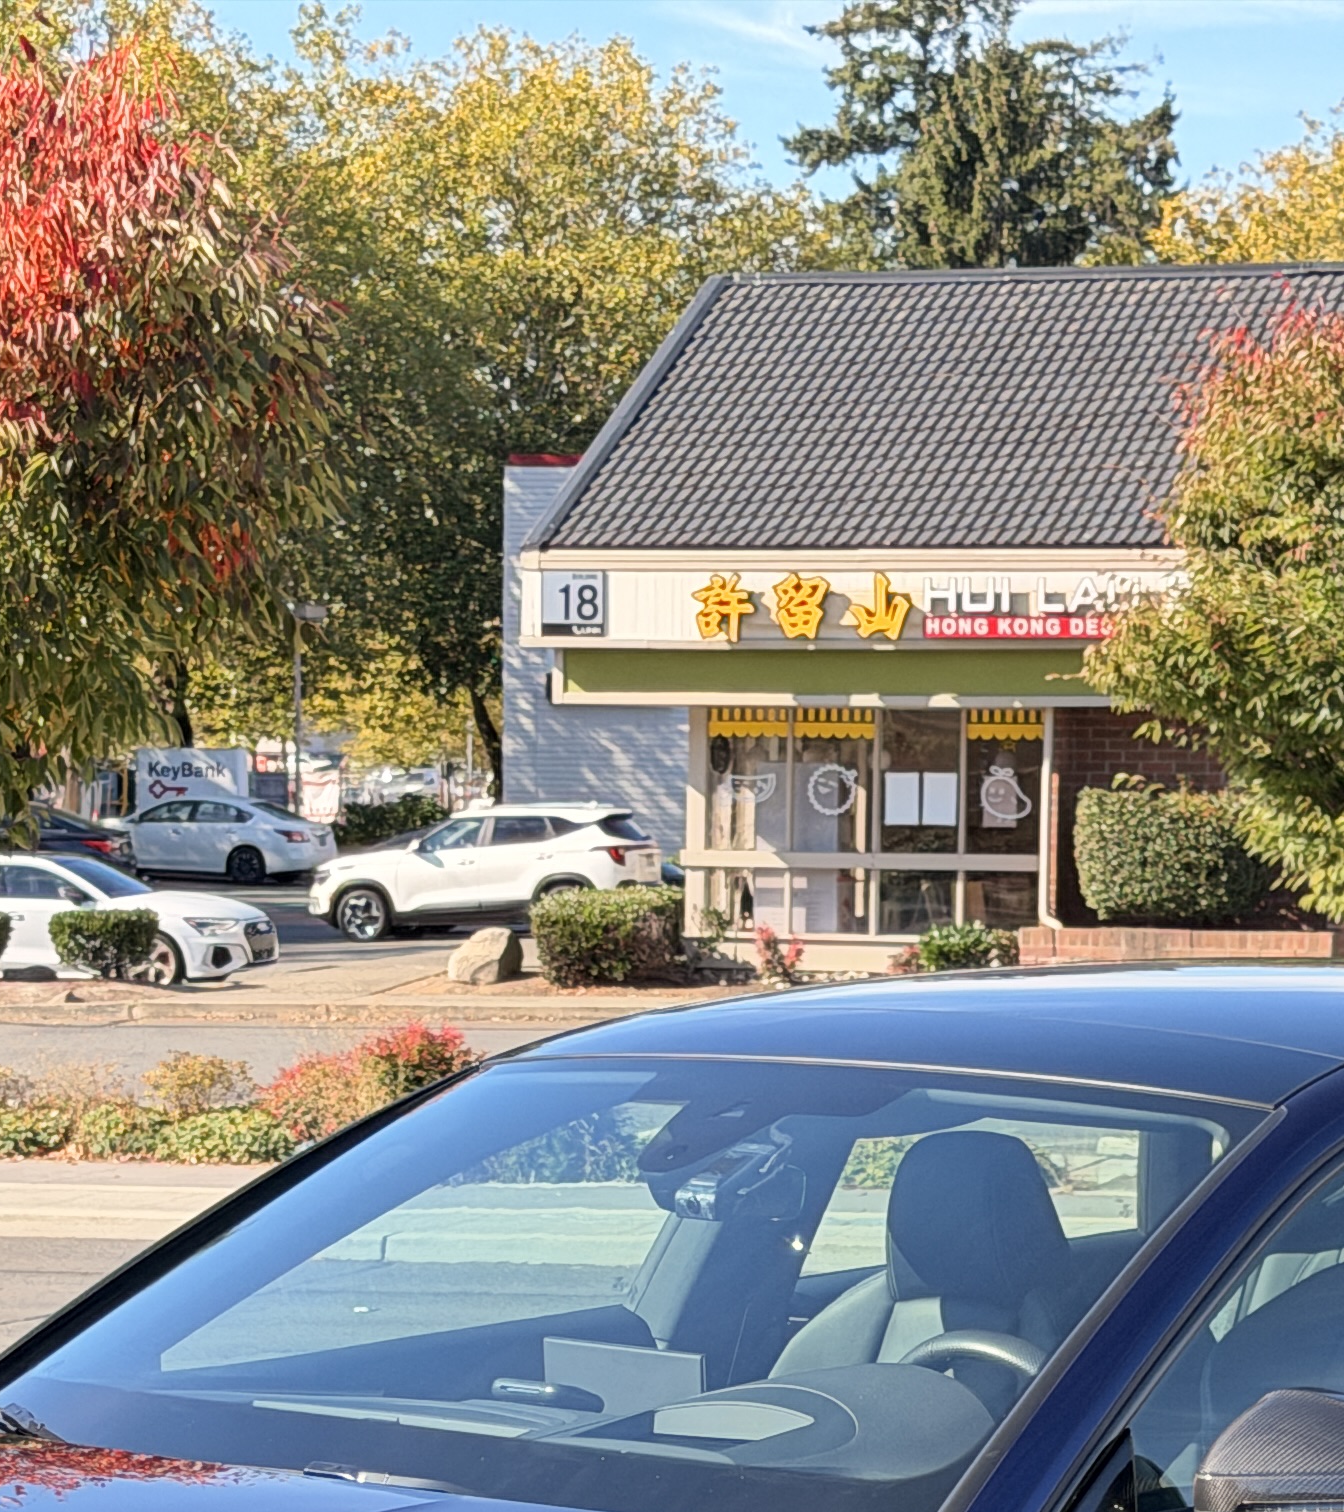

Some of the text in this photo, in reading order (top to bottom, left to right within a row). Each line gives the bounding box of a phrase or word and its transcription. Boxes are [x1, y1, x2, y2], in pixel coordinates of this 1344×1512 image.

[558, 584, 599, 621] 18
[692, 572, 911, 643] 許留山
[923, 576, 1011, 613] HUI
[925, 616, 1115, 636] HONG KONG DES
[147, 761, 226, 780] KeyBank
